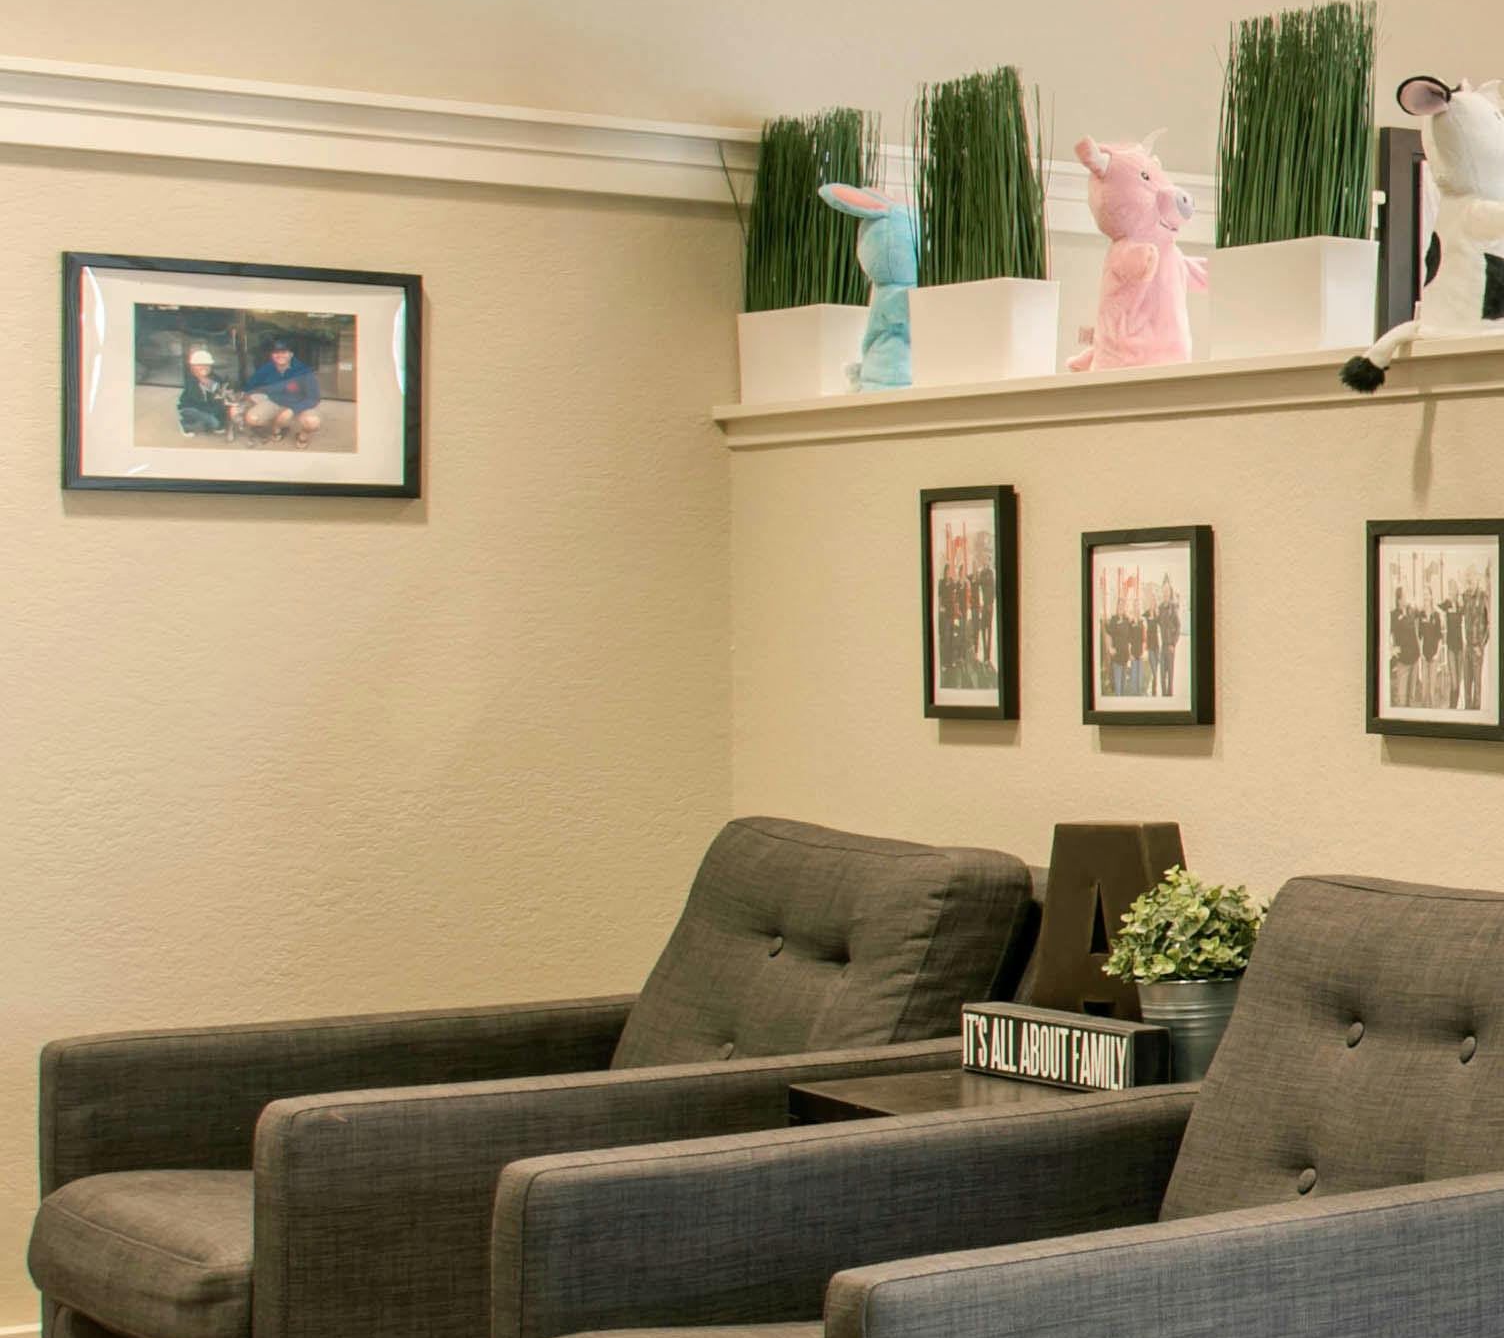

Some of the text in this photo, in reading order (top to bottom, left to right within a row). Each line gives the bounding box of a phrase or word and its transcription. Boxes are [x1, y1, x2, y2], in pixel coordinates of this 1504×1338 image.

[963, 1012, 1127, 1091] IT'S ALL ABOUT FAMILY
